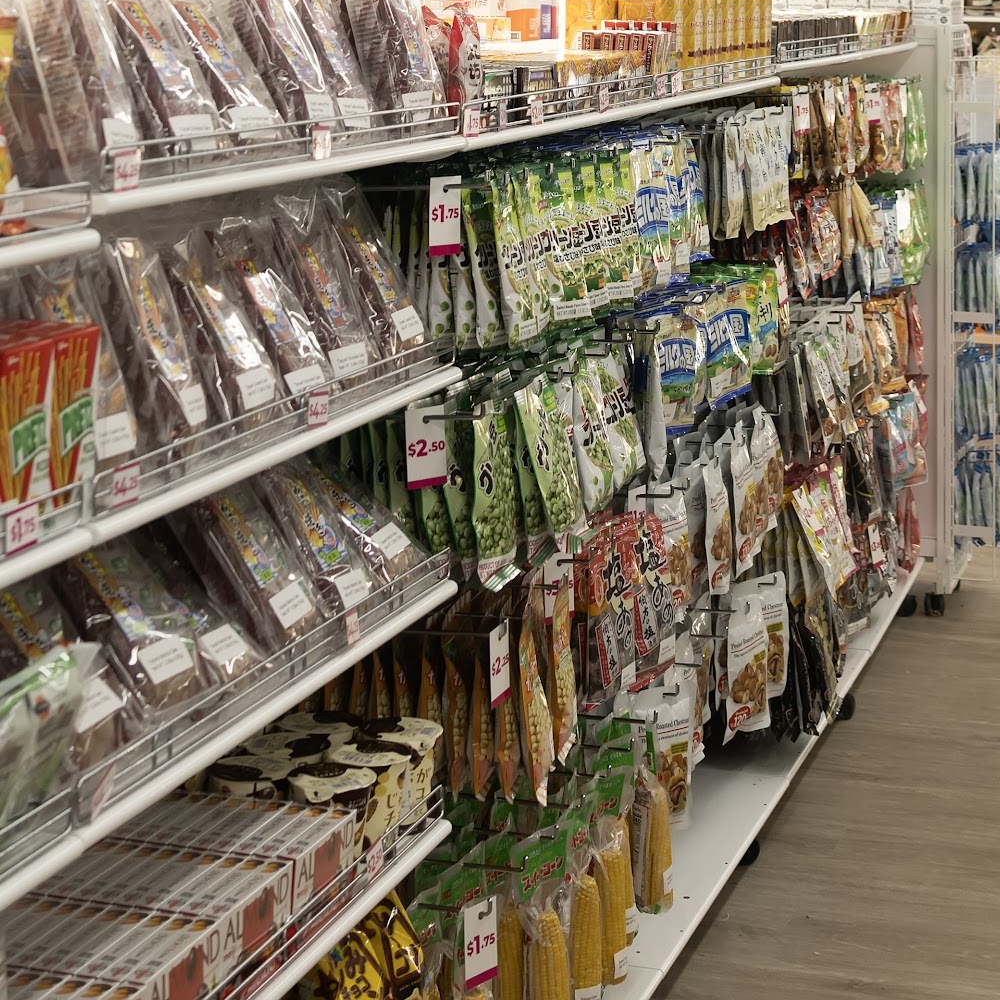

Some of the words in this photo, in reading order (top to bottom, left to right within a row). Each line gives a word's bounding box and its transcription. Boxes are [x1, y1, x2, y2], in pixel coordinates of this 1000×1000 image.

[431, 204, 459, 223] $1.75
[659, 343, 696, 374] ミルクの国
[309, 402, 329, 418] $4.25
[408, 439, 445, 458] $2.50
[656, 720, 673, 730] Roasted
[466, 932, 496, 957] $1.75
